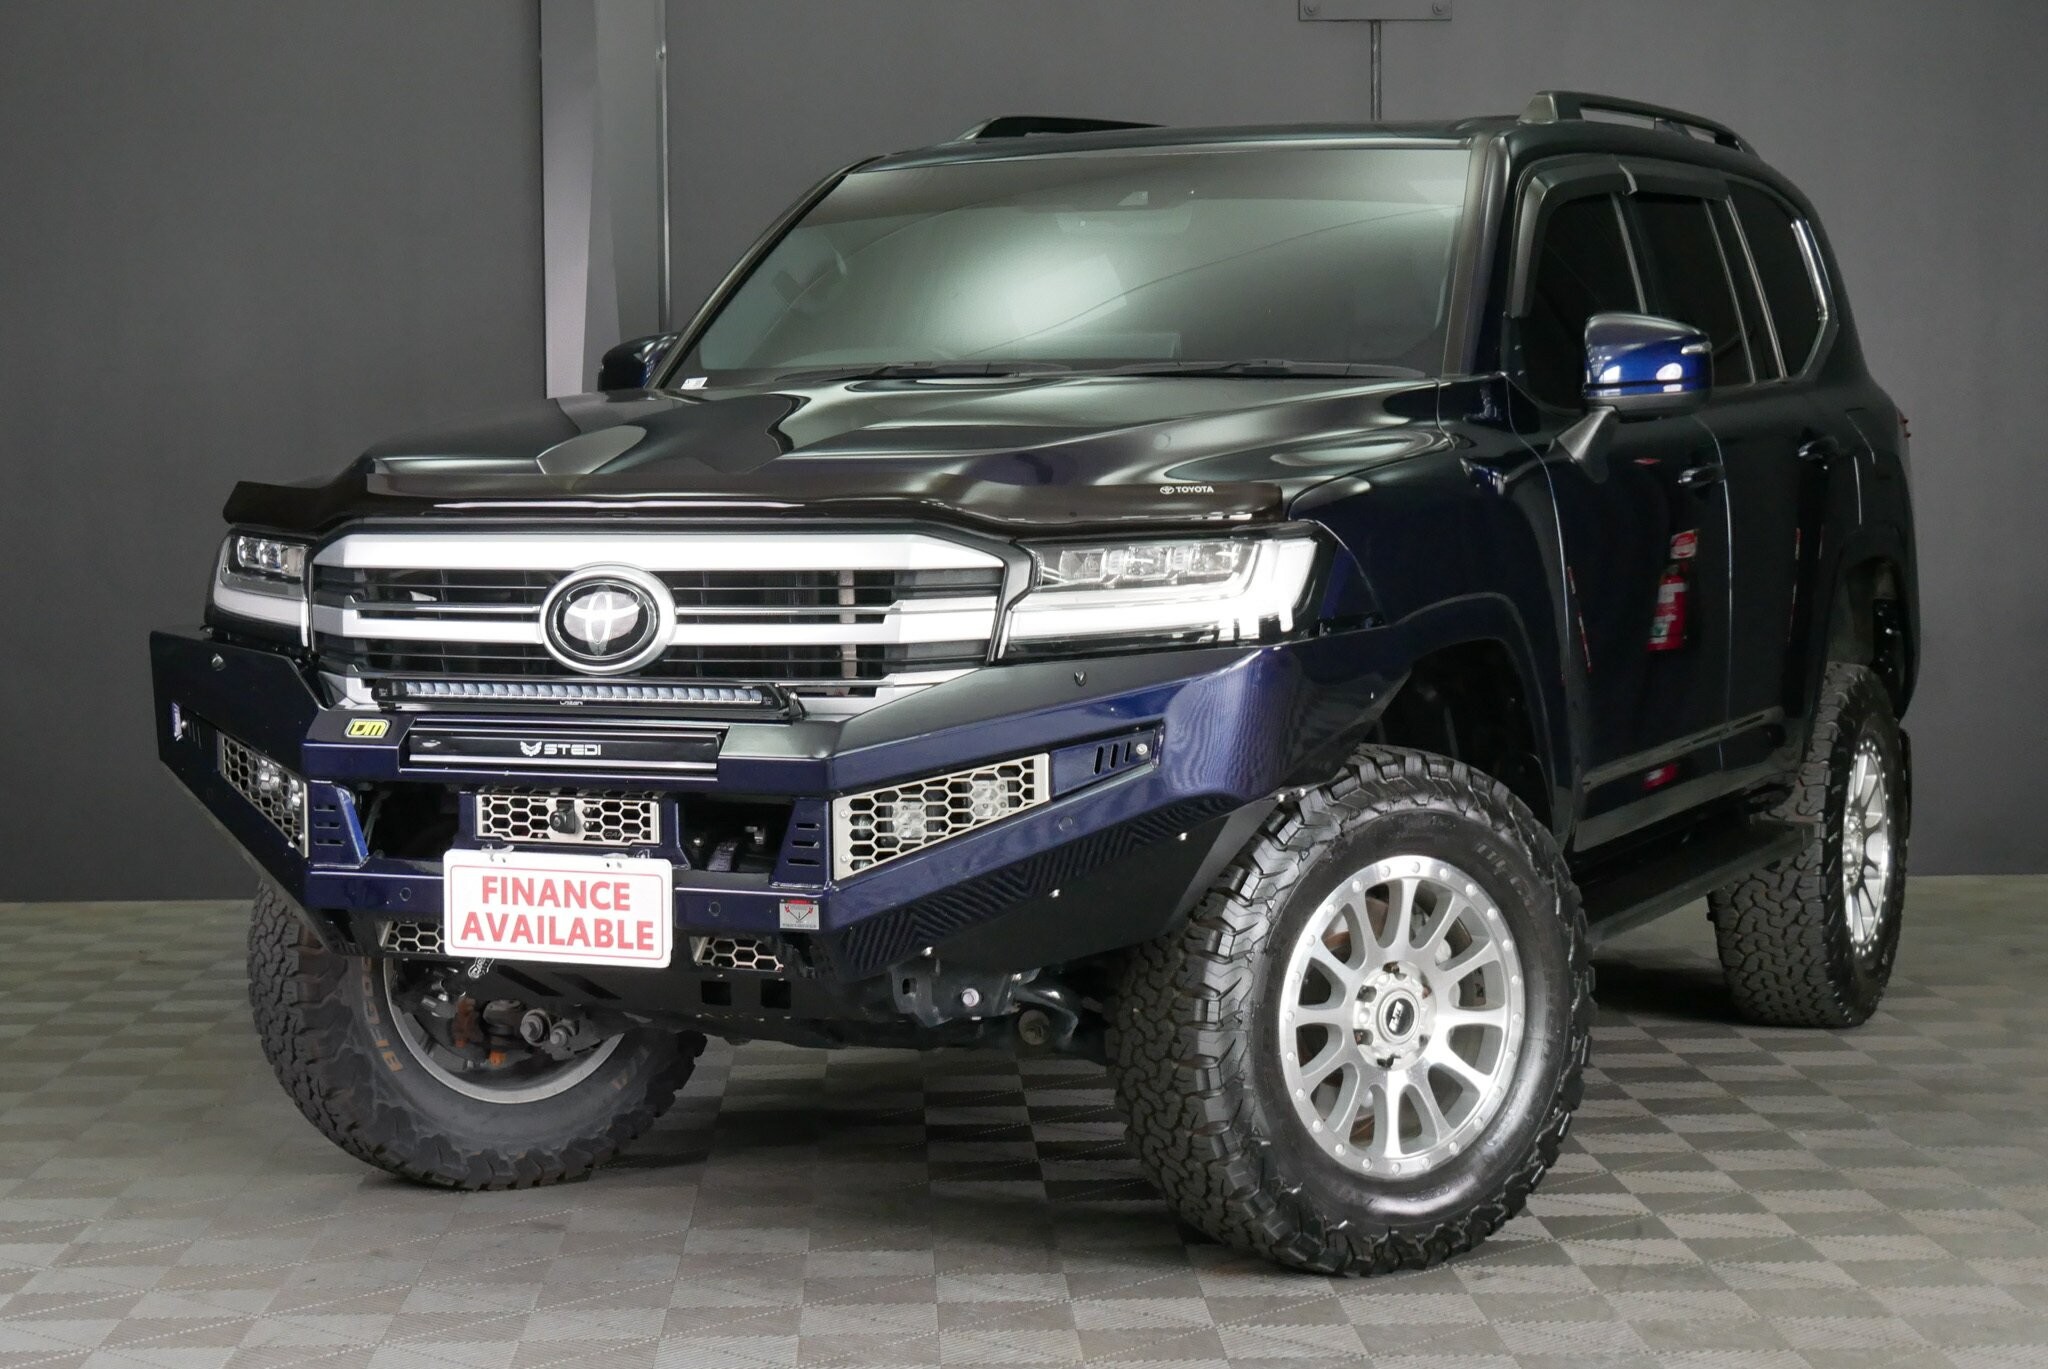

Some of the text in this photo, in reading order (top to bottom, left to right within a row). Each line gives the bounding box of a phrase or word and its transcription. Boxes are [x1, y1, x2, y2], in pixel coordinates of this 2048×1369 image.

[1175, 485, 1215, 494] TOYOTA
[543, 743, 602, 756] STEDI
[482, 875, 631, 911] FINANCE
[460, 911, 654, 950] AVAILABLE
